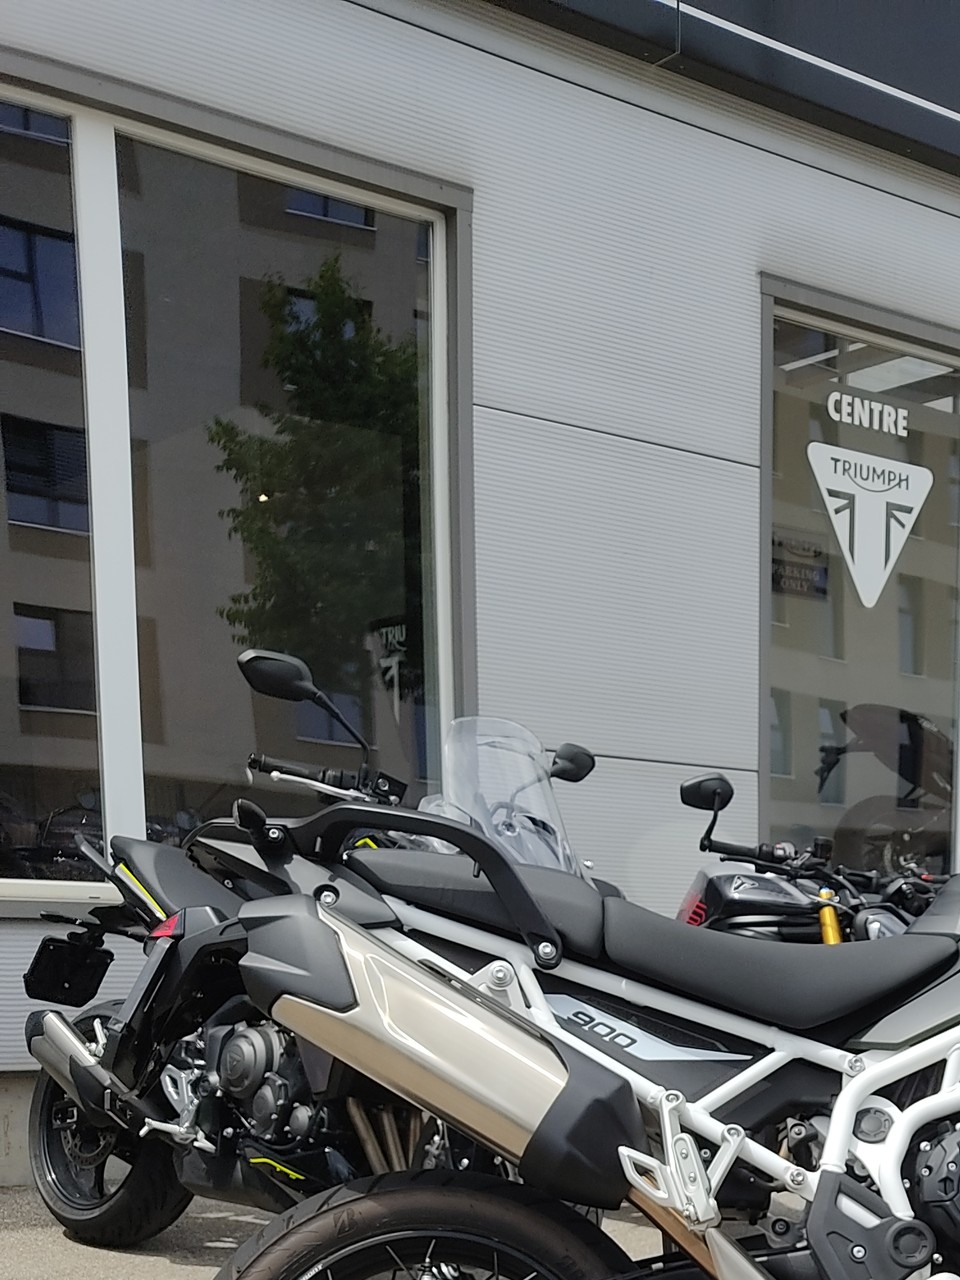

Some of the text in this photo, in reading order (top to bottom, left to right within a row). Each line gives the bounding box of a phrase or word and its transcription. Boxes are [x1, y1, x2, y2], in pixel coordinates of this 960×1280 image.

[826, 391, 909, 437] CENTRE
[830, 457, 909, 491] TRIUMPH
[567, 1010, 638, 1049] 900
